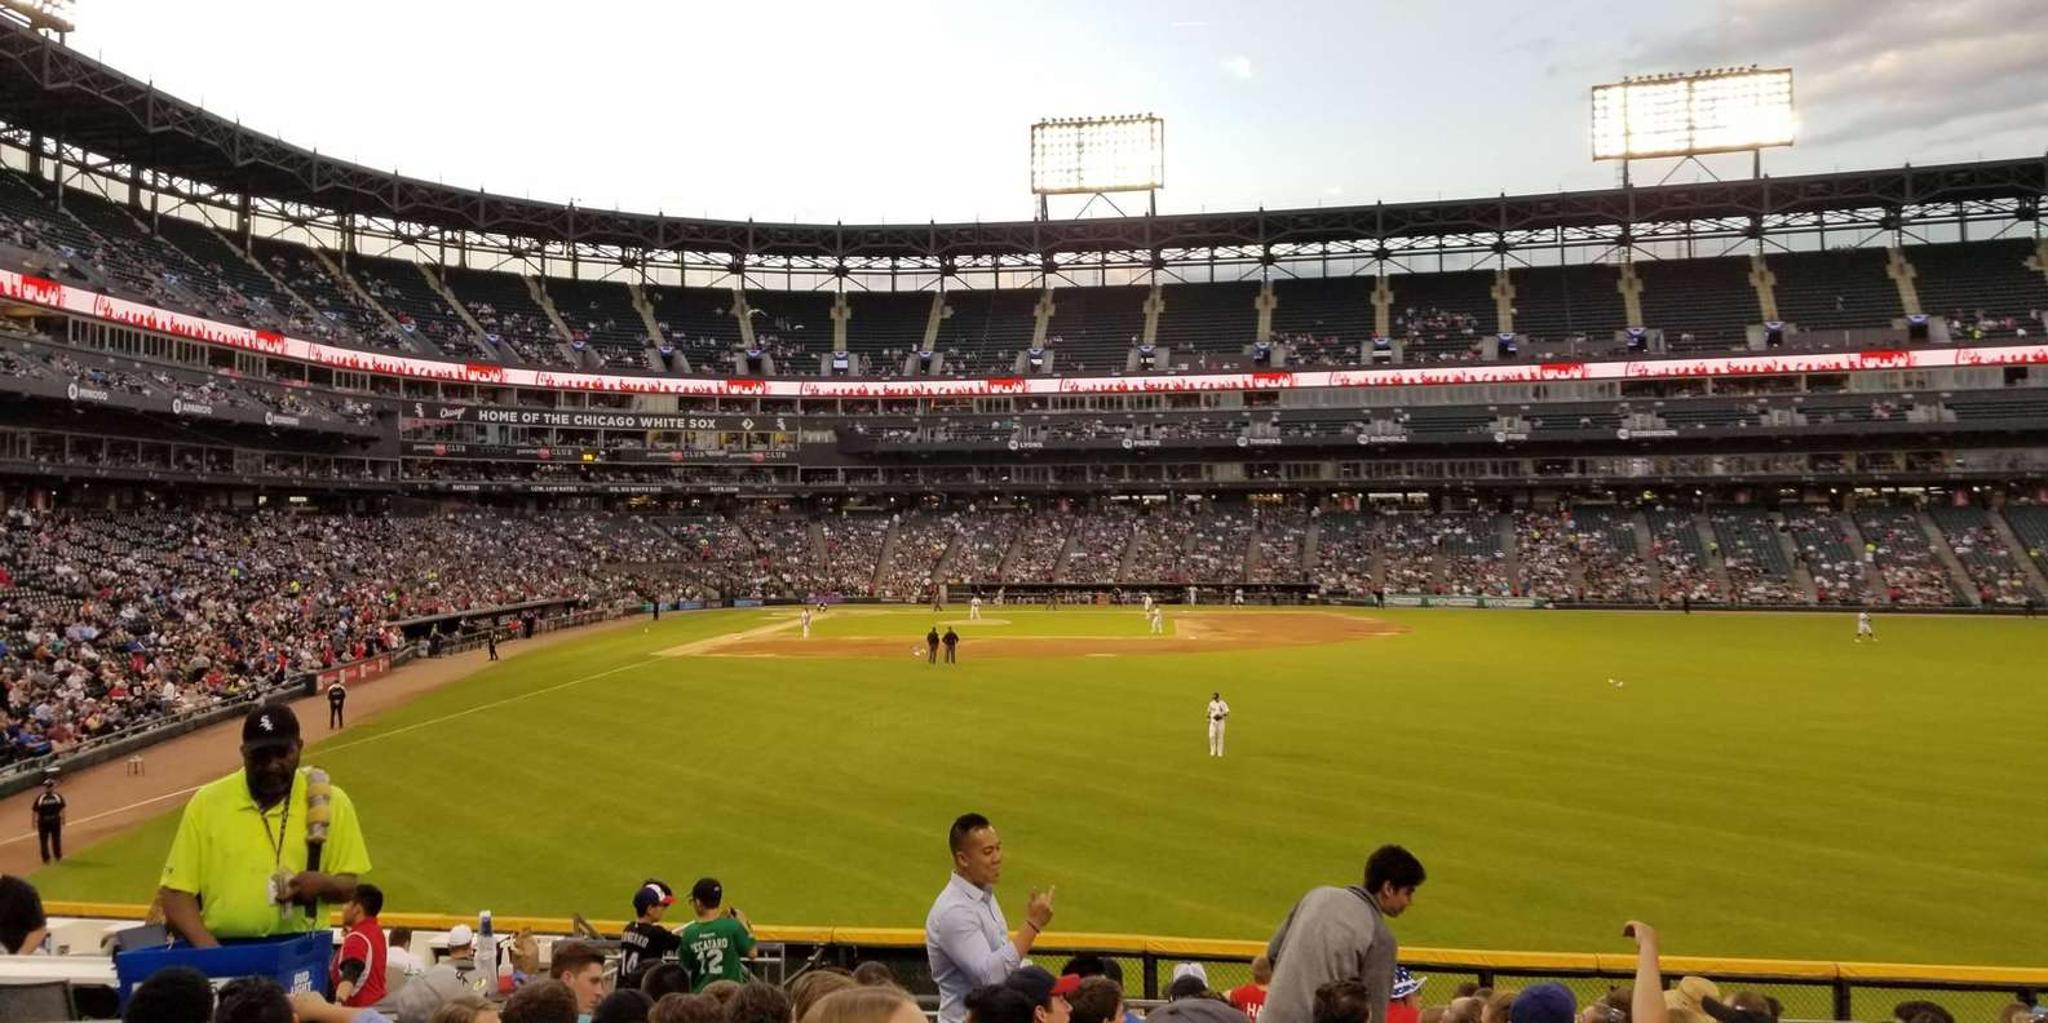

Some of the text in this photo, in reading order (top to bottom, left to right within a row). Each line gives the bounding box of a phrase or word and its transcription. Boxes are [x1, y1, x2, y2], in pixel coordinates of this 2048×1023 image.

[478, 410, 717, 430] HOME OF THE CHICAGO WHITE SOX
[697, 949, 724, 975] 12
[294, 970, 310, 985] BUD
